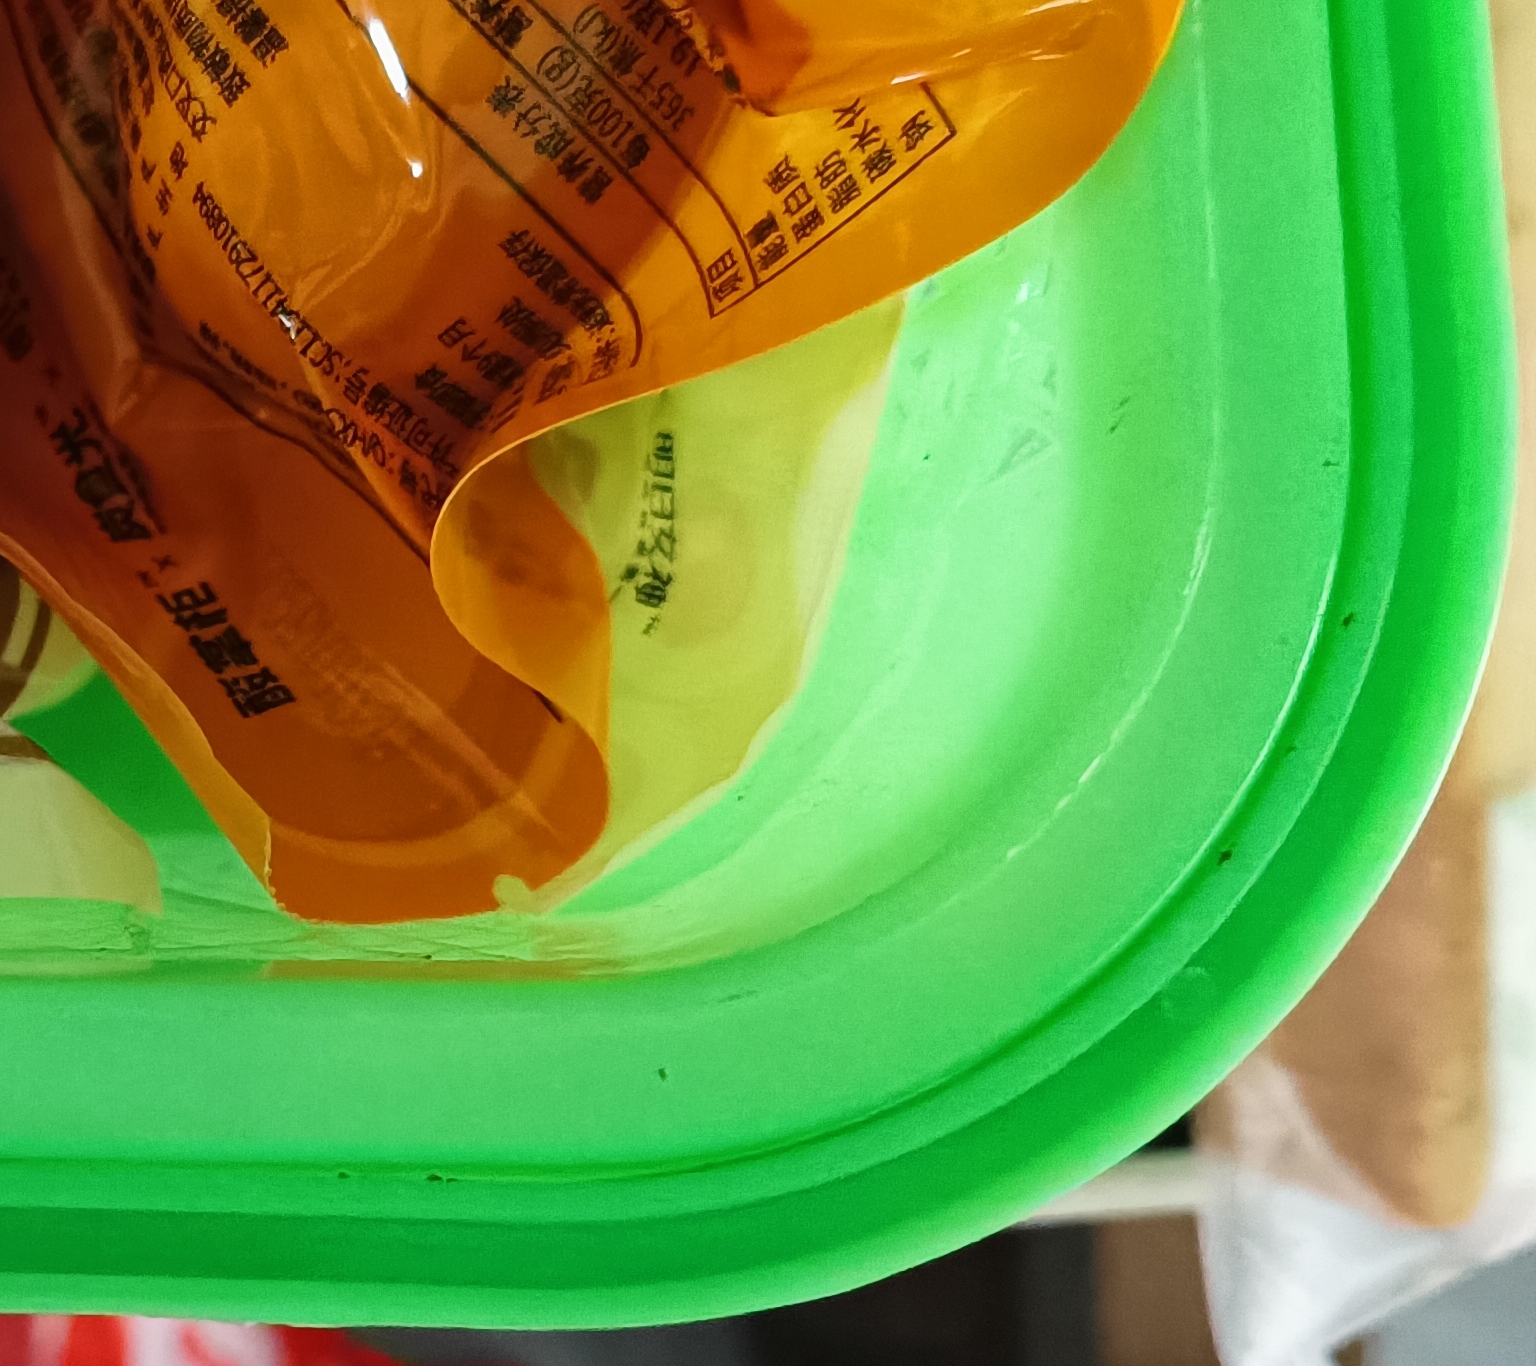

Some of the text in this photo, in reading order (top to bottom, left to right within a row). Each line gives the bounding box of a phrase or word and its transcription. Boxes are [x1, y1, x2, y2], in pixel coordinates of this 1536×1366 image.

[536, 44, 652, 176] 每100克(g)
[572, 3, 695, 140] 365千焦(kJ)
[485, 75, 615, 206] 营养成分表
[898, 109, 934, 153] 钠
[763, 154, 825, 244] 蛋白质
[813, 149, 862, 215] 脂肪
[695, 247, 745, 303] 项目
[735, 210, 789, 272] 能量
[154, 581, 298, 719] 酸掌柜
